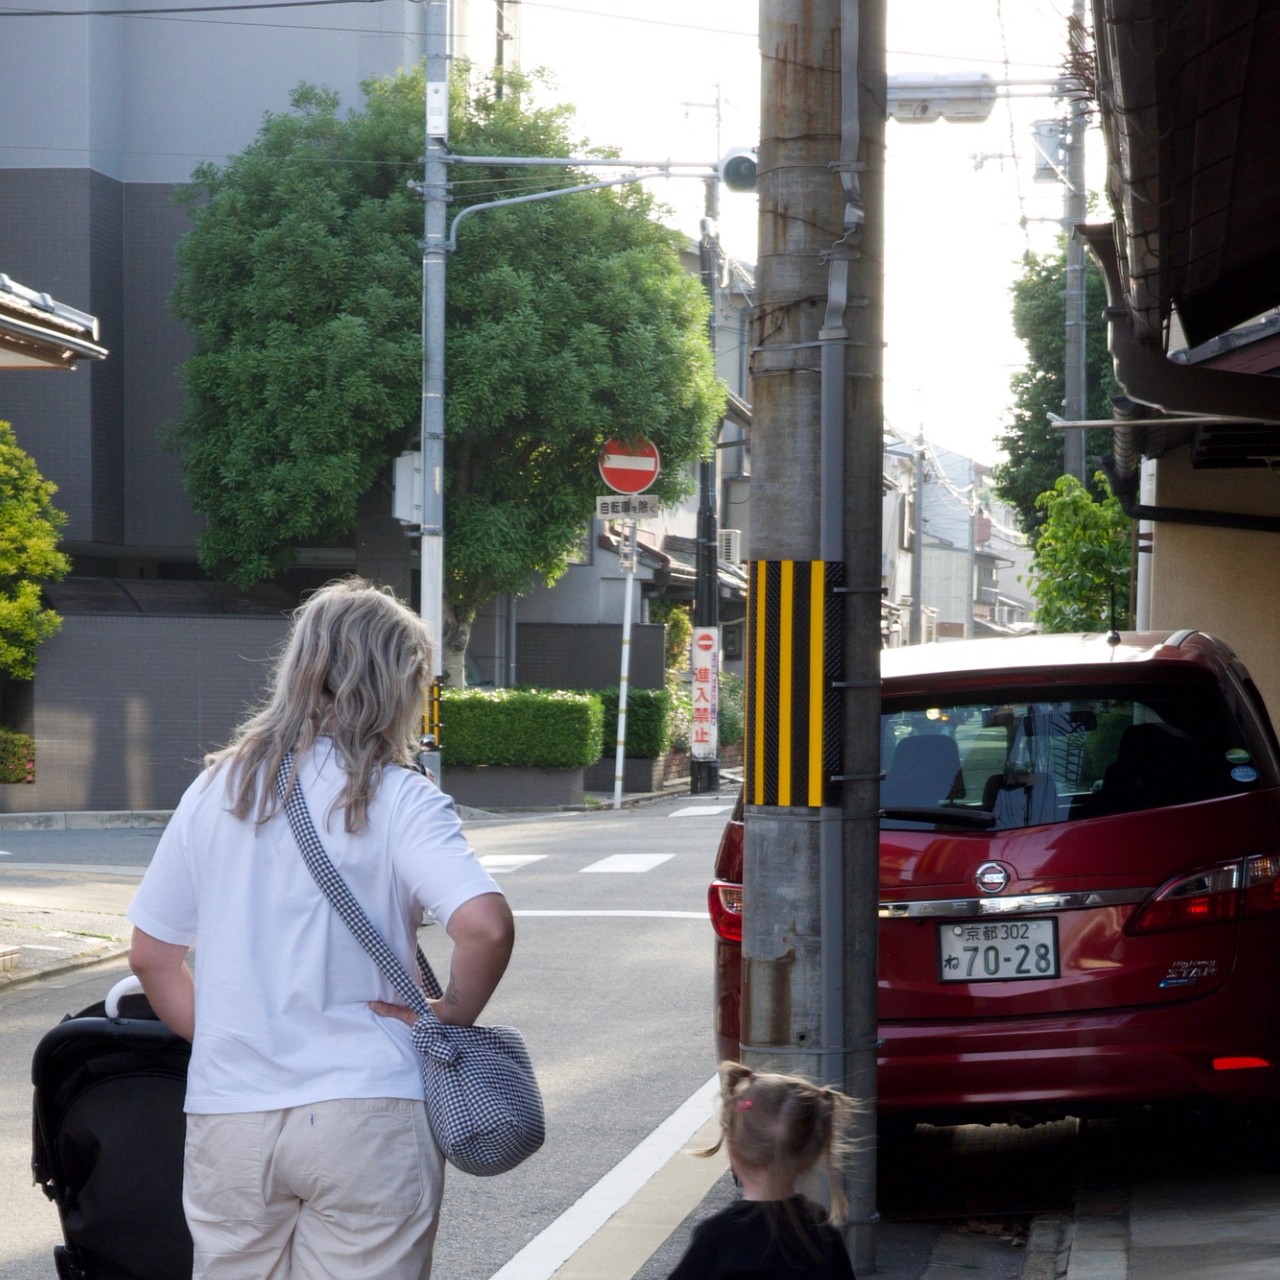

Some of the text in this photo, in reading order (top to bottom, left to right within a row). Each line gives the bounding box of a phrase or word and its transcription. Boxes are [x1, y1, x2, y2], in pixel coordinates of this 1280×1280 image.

[600, 500, 656, 514] 自転車を除く
[694, 666, 710, 743] 進入禁止
[943, 942, 1052, 977] ね 70-28
